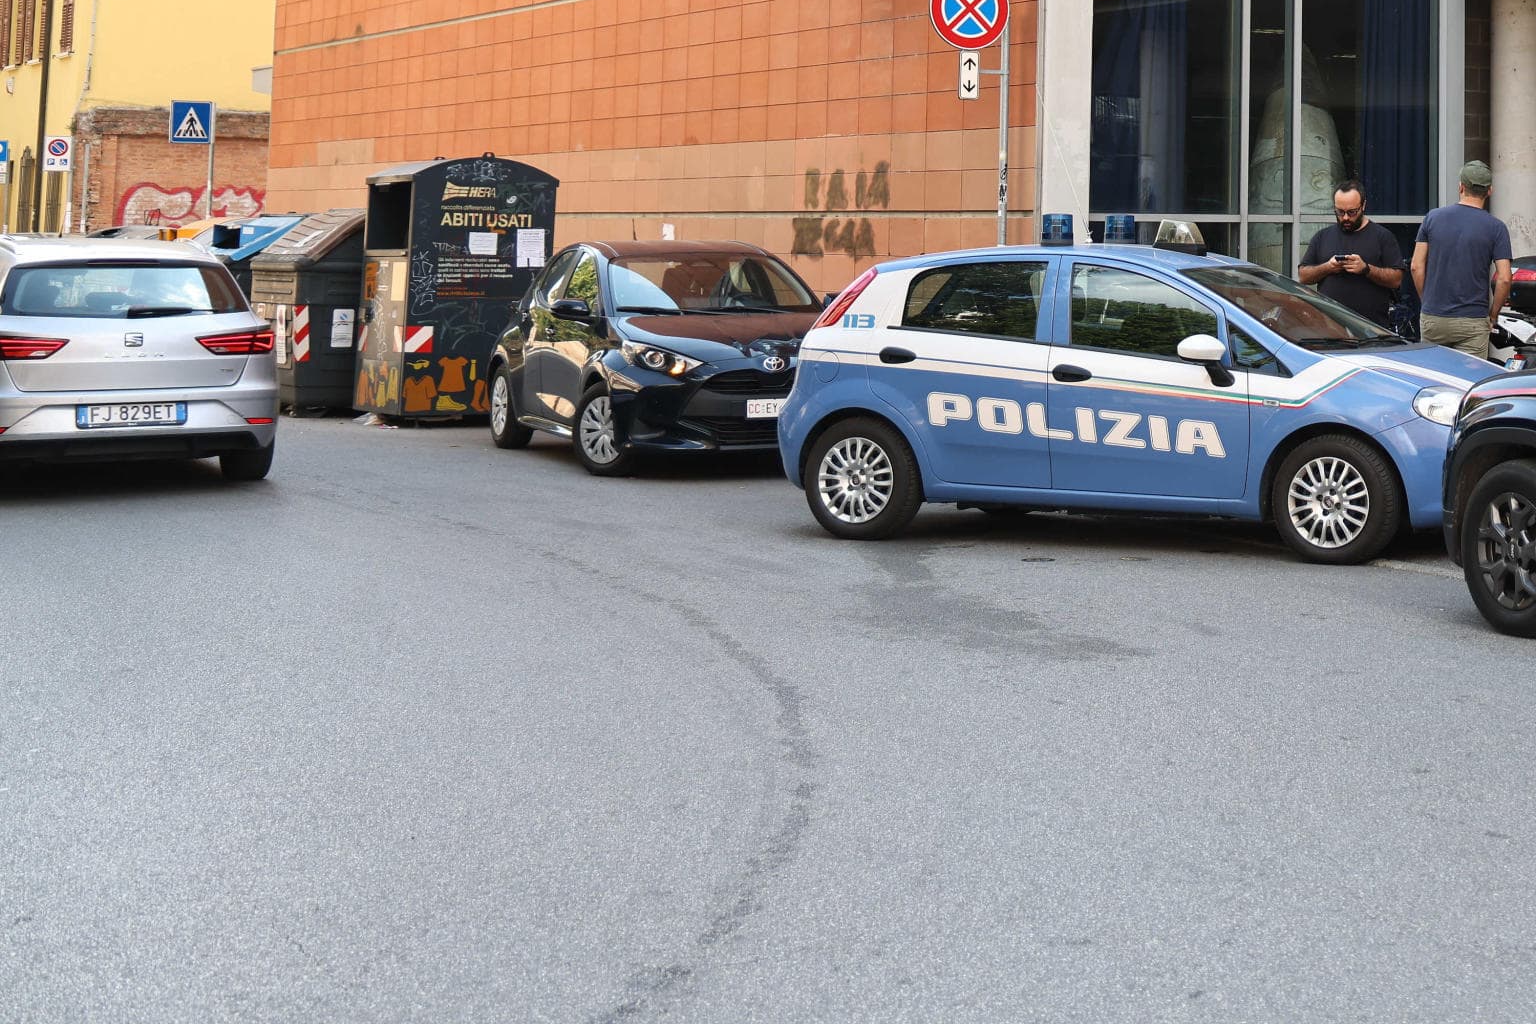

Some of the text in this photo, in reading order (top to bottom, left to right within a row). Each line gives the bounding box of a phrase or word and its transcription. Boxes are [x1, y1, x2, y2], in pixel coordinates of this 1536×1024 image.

[469, 186, 496, 198] HERA
[441, 212, 532, 228] ABITI USATI
[843, 314, 876, 328] 113
[90, 405, 174, 422] FJ 829ET
[748, 403, 778, 414] CC EY
[926, 391, 1227, 459] POLIZIA
